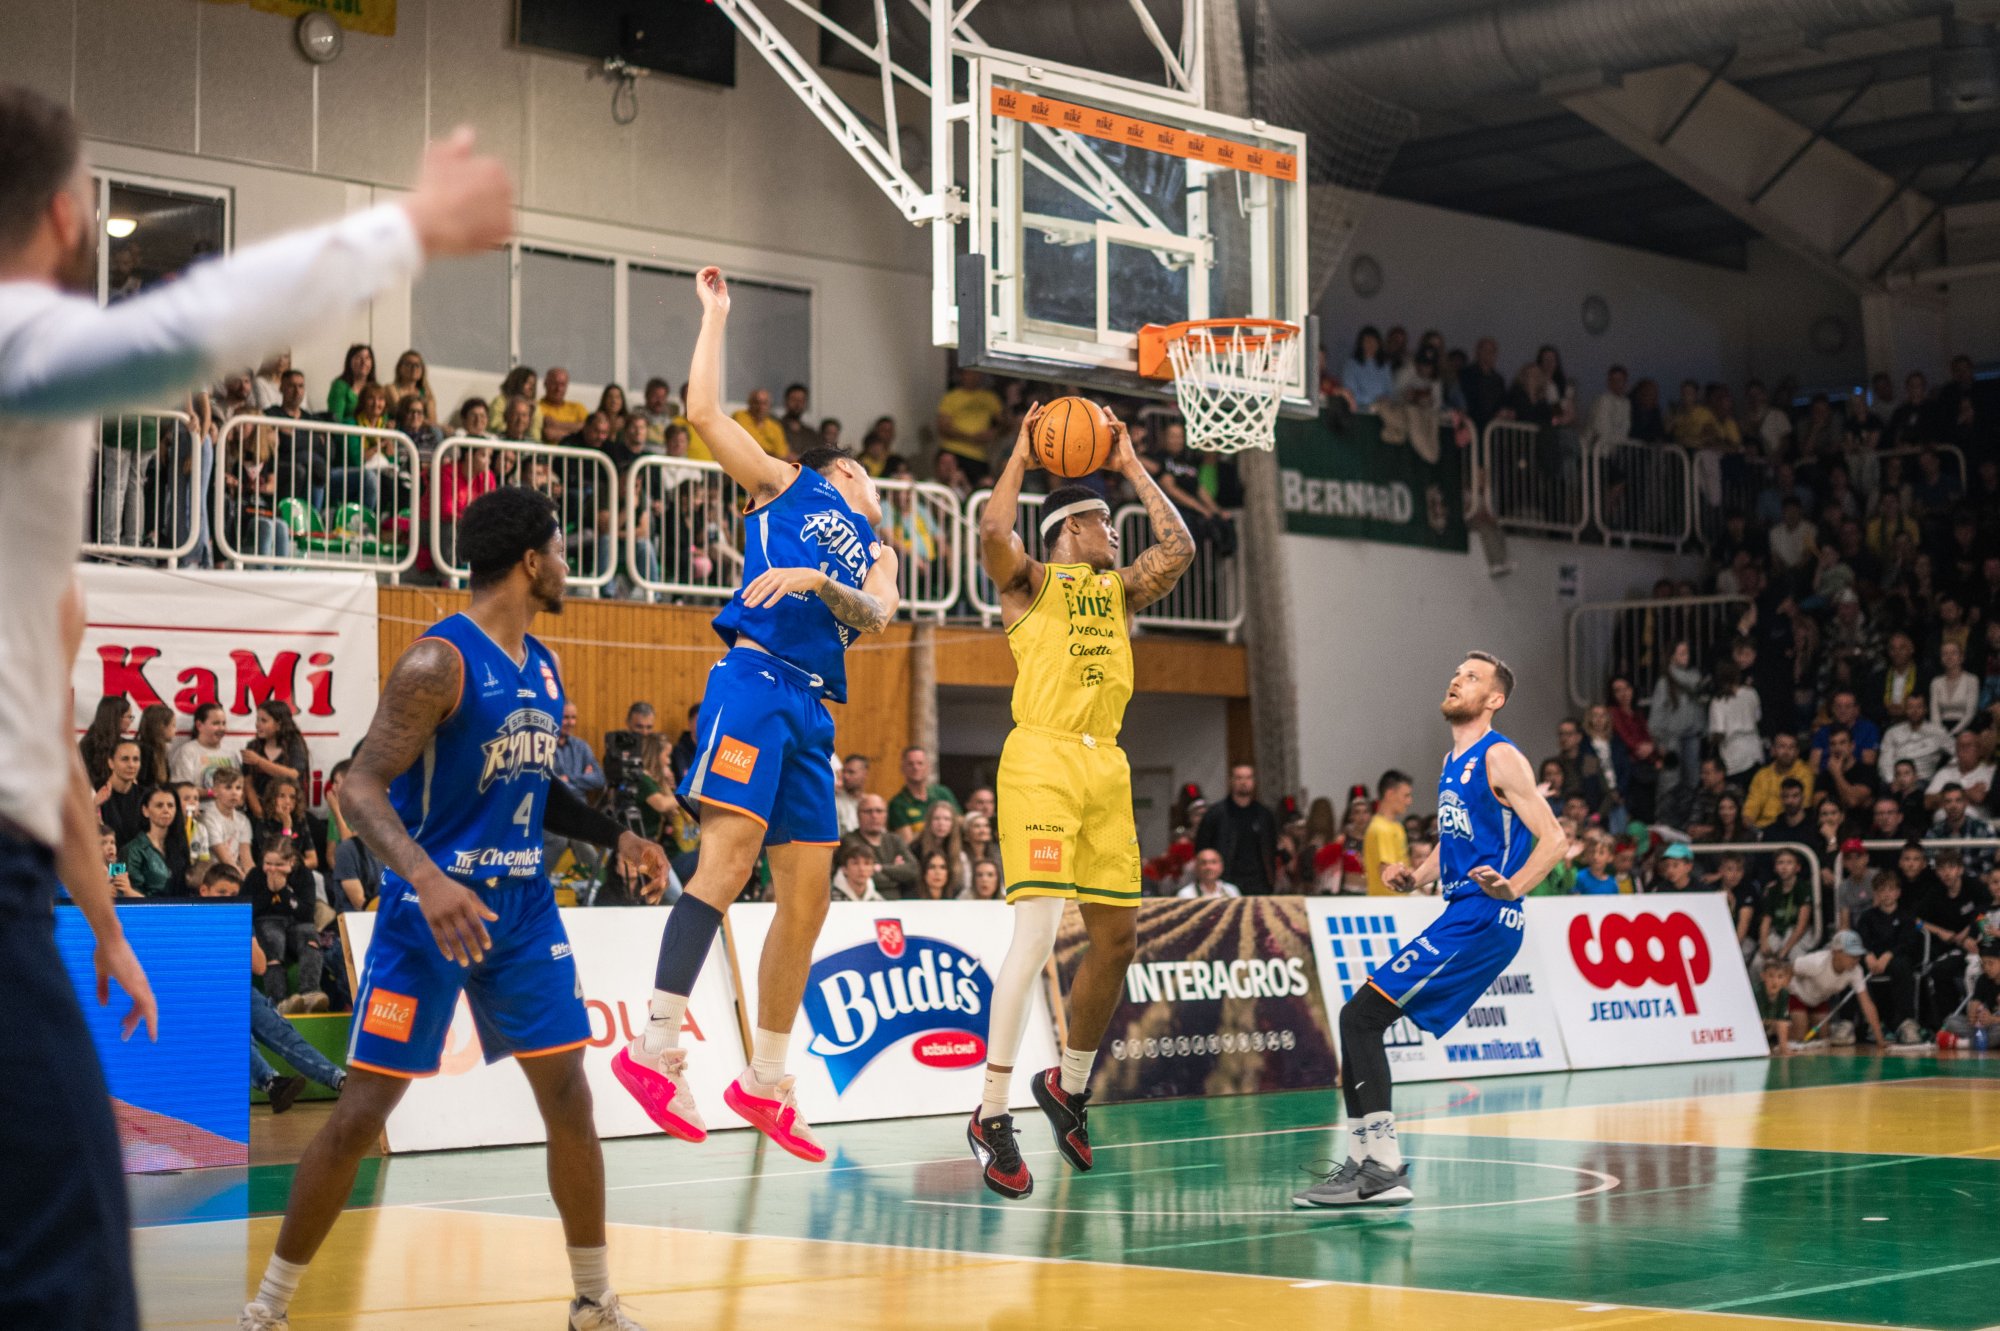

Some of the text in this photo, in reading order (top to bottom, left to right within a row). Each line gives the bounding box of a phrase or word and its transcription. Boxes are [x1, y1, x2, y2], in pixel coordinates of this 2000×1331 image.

[1076, 625, 1114, 638] VEOLIA
[96, 644, 336, 717] KaMi
[721, 749, 752, 768] niké
[513, 792, 534, 838] 4
[1034, 846, 1059, 860] niké
[1392, 950, 1419, 974] 6
[1126, 956, 1309, 1003] INTERAGROS
[372, 1001, 410, 1024] niké
[810, 948, 982, 1056] Budiš
[1589, 998, 1677, 1021] JEDNOTA
[1692, 1027, 1734, 1044] LEVICE
